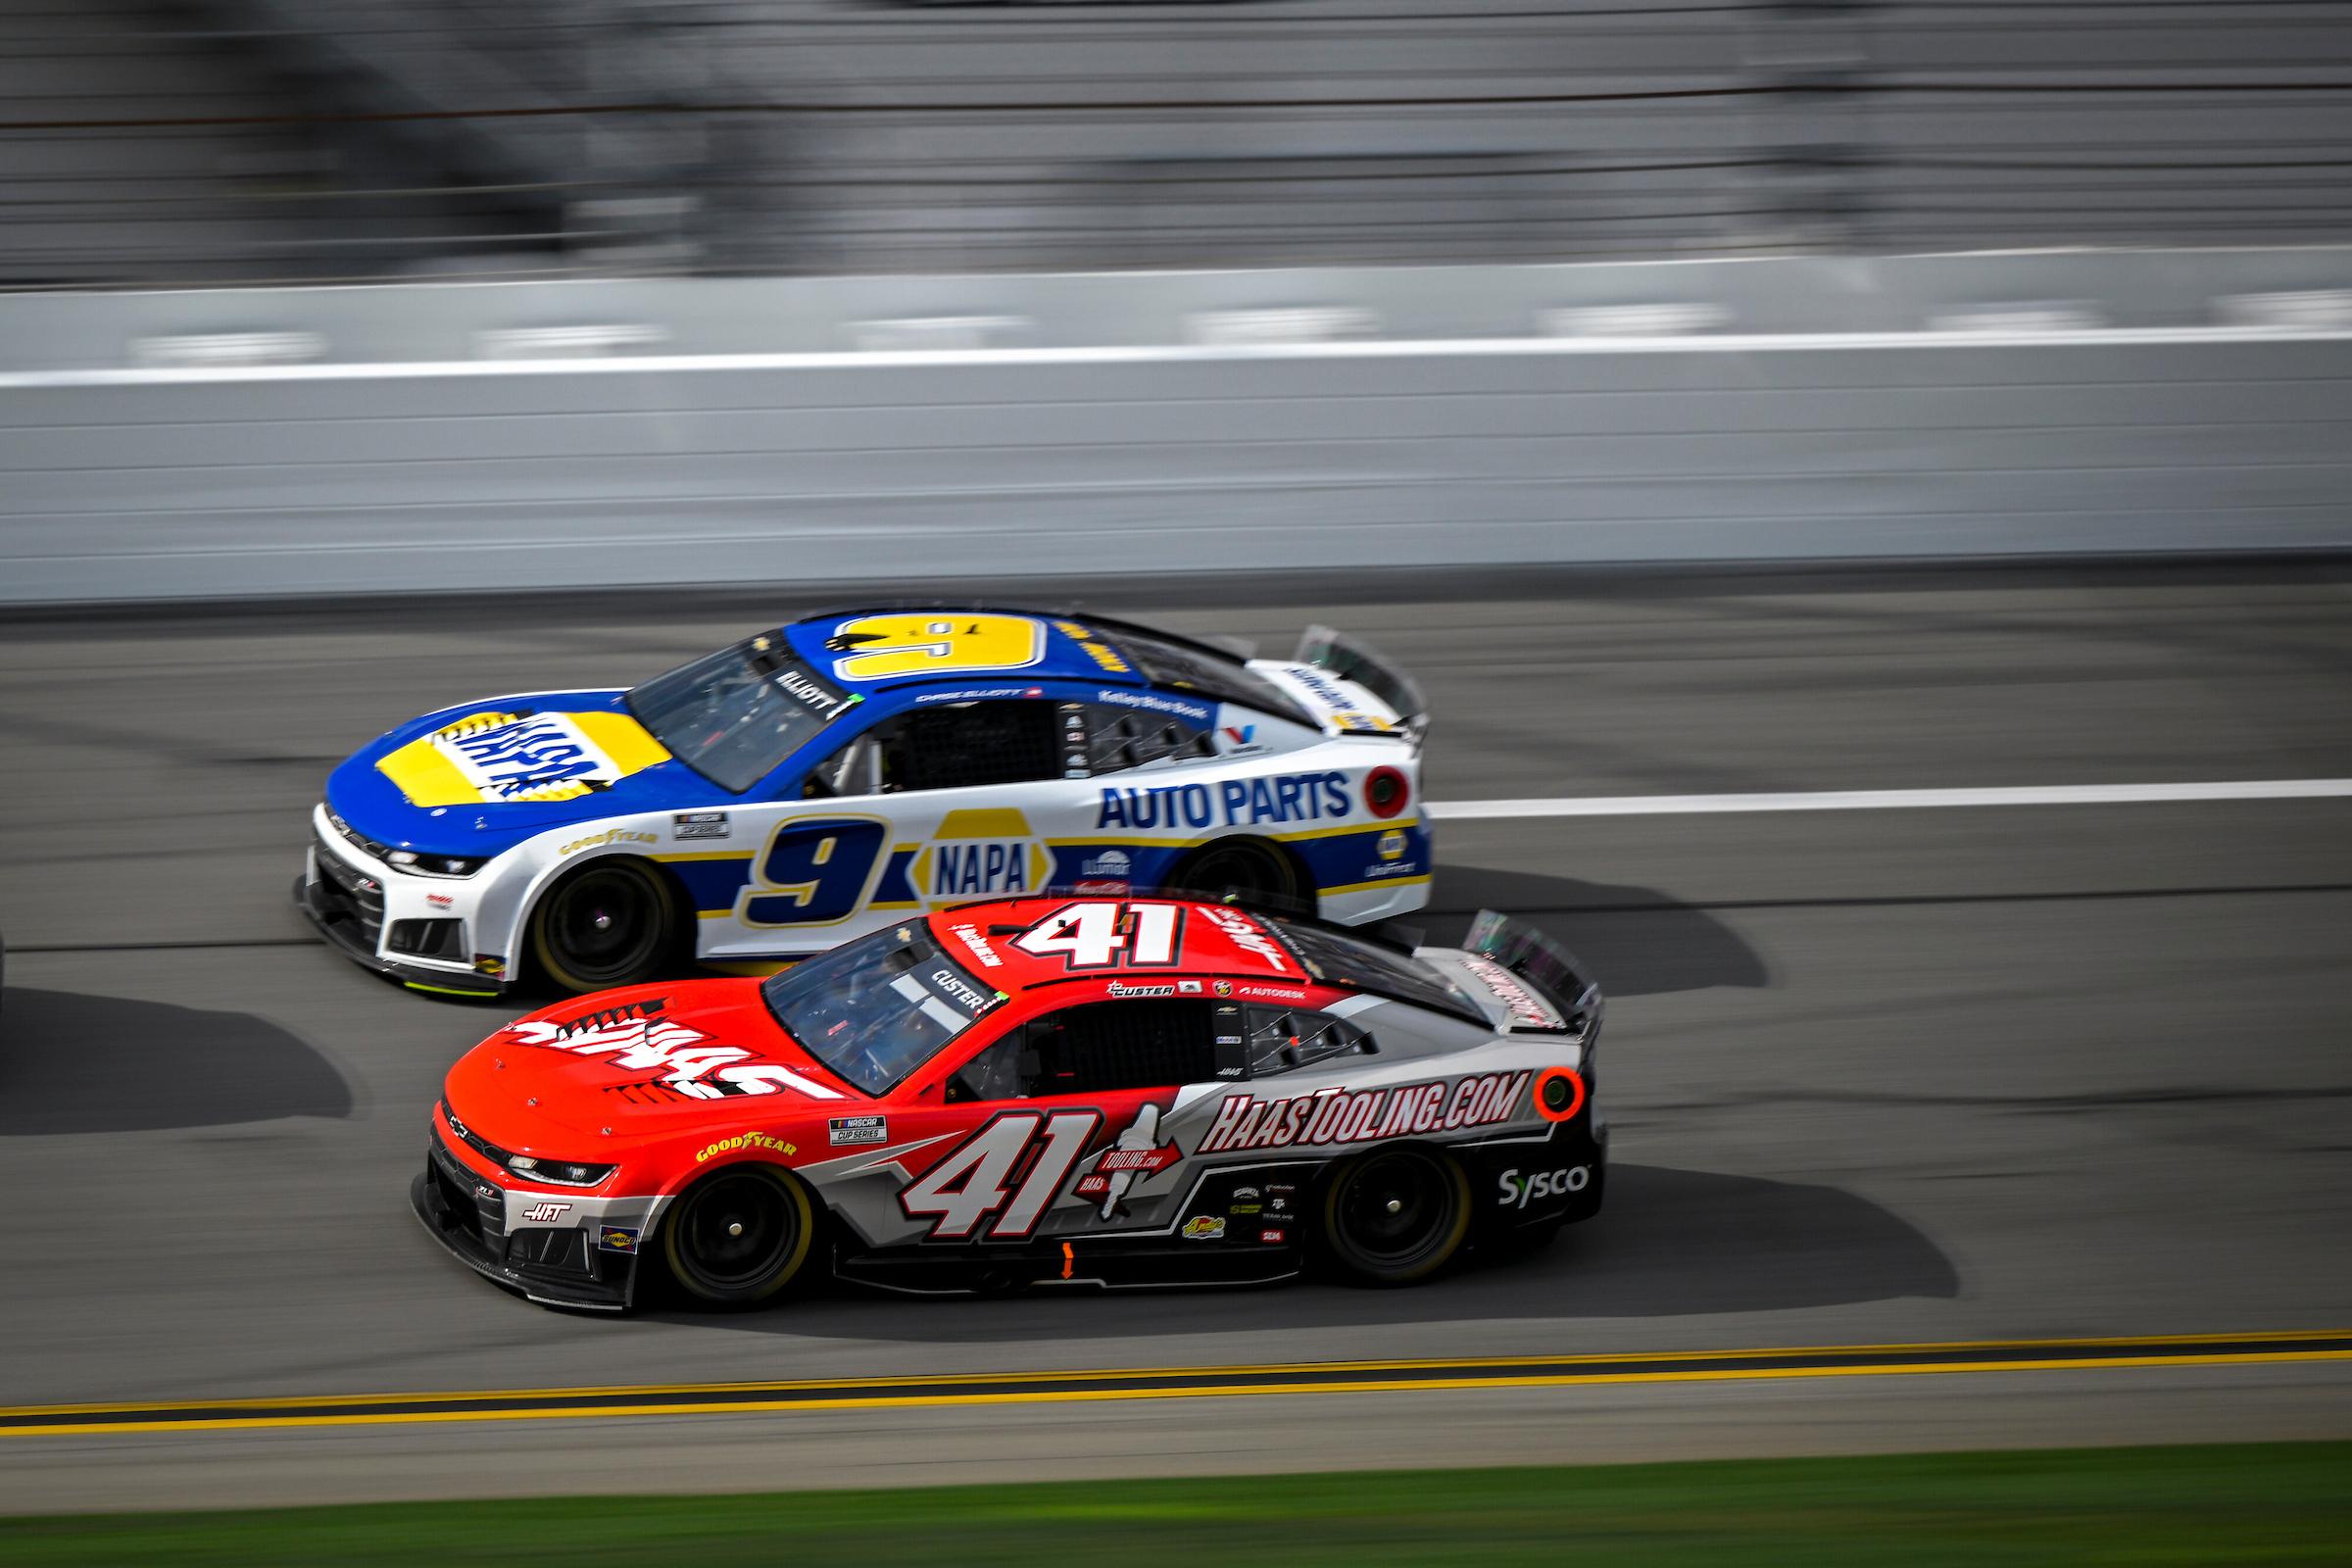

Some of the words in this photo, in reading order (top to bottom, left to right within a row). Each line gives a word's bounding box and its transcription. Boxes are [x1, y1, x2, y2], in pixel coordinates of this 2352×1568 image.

[1099, 783, 1212, 829] AUTO
[1223, 771, 1350, 825] PARTS
[742, 813, 893, 926] 9
[937, 843, 1028, 895] NAPA
[1012, 902, 1181, 967] 41
[931, 969, 985, 1009] CUSTER
[1251, 987, 1306, 999] AUTODESK
[838, 1130, 853, 1140] CUP
[853, 1129, 879, 1139] SERIES
[847, 1118, 879, 1128] NASCAR
[696, 1130, 798, 1163] GOODYEAR
[901, 1112, 1101, 1238] 41
[1079, 1176, 1105, 1192] HAAS
[522, 1203, 572, 1223] HFT
[601, 1235, 637, 1247] SUNOCO
